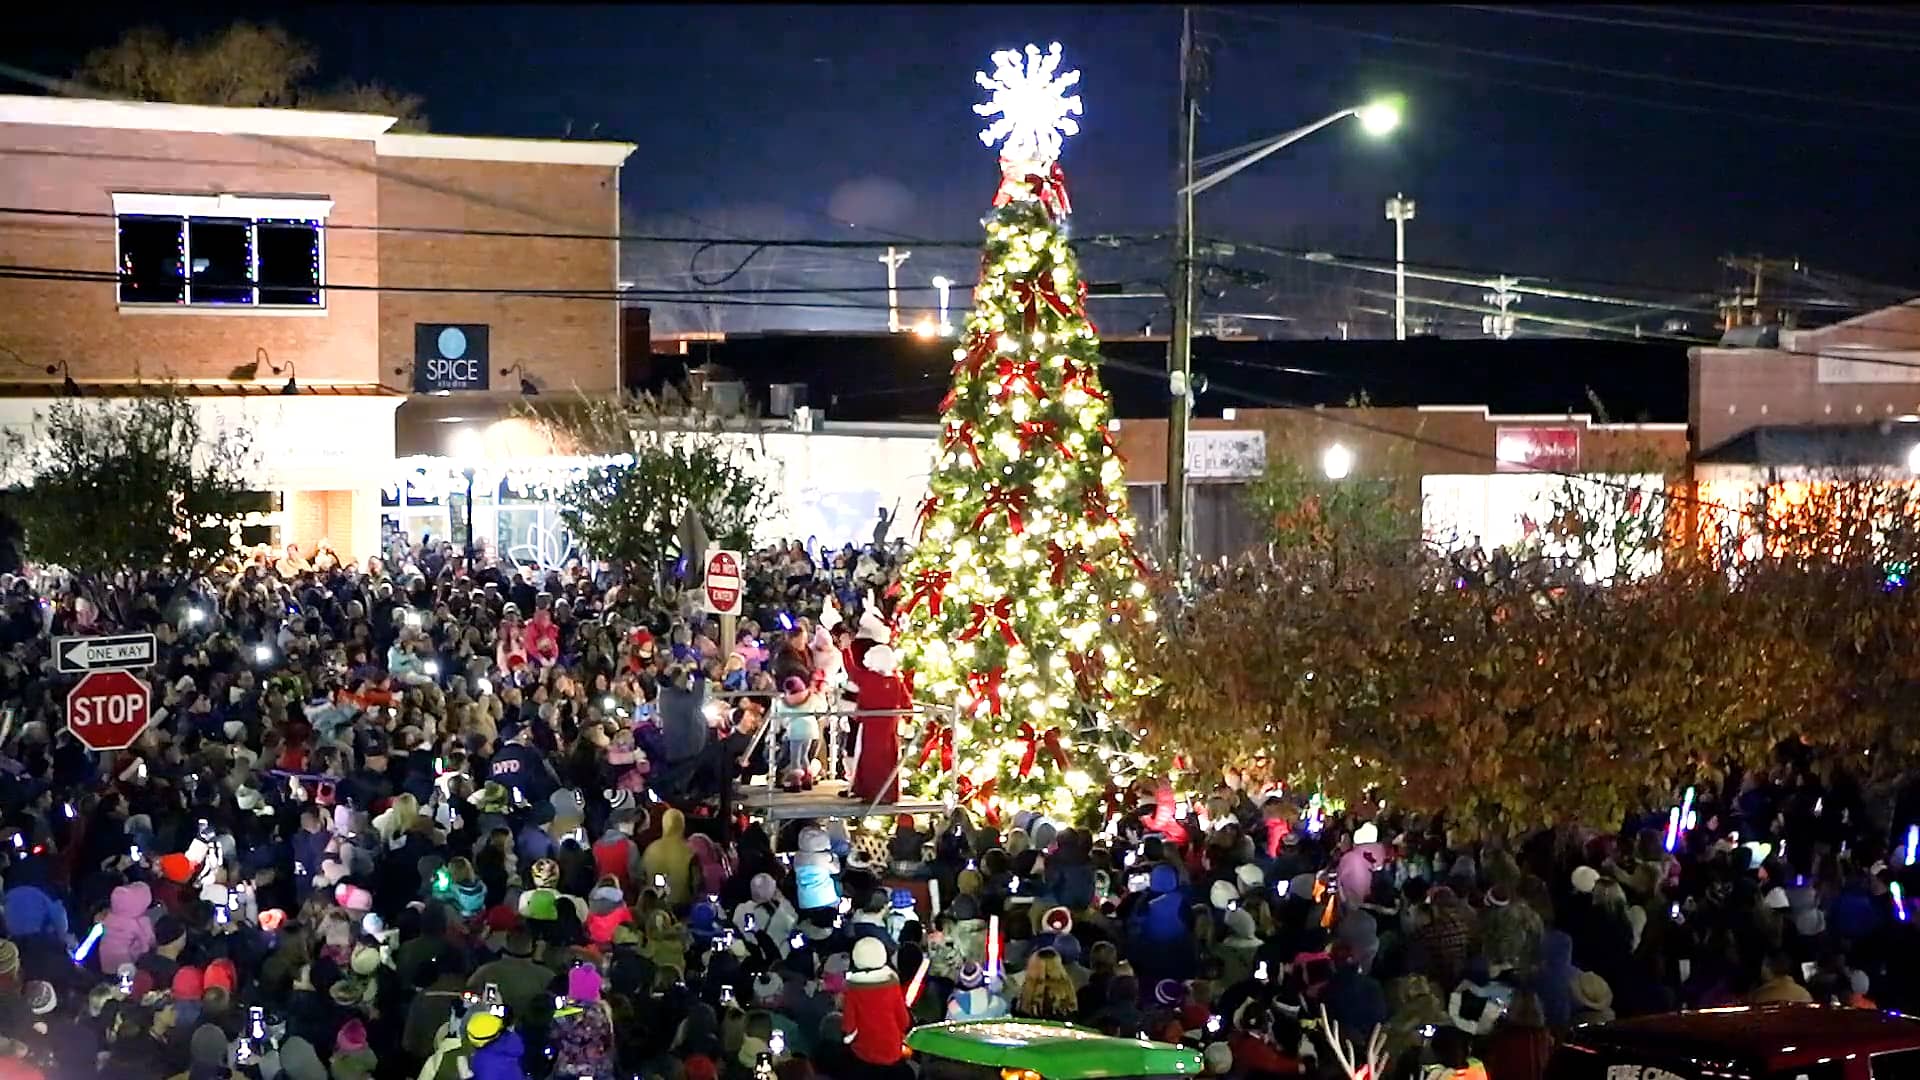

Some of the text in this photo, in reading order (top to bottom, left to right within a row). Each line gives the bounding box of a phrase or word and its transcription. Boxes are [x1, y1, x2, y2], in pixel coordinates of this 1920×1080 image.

[426, 359, 478, 380] SPICE
[87, 646, 144, 660] ONE WAY
[73, 693, 144, 726] STOP
